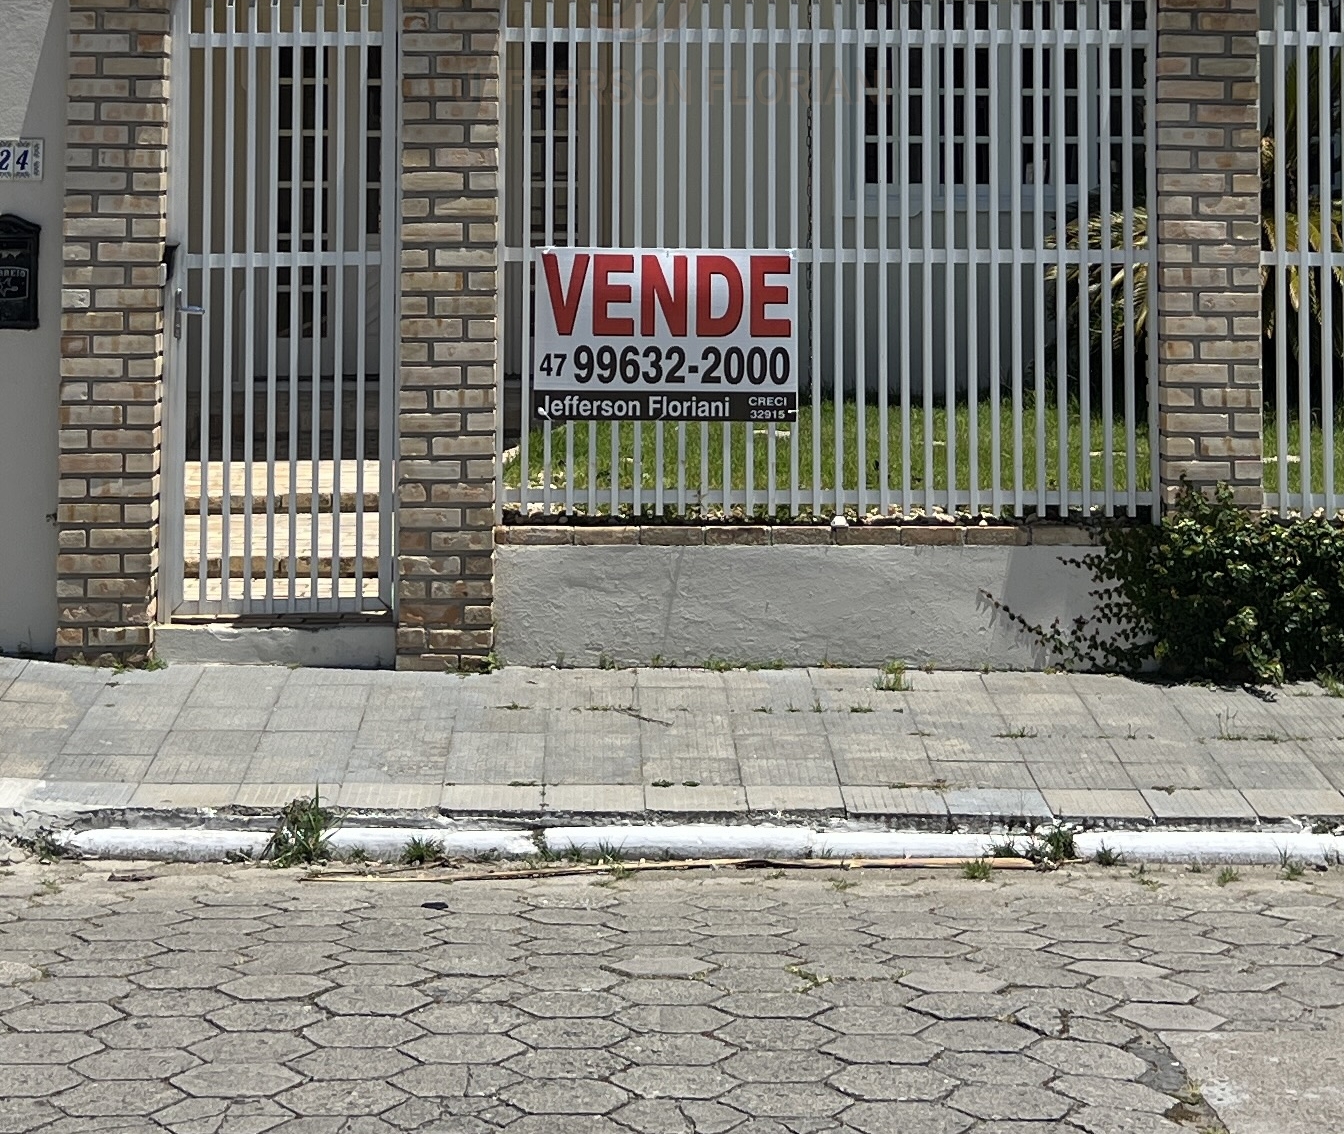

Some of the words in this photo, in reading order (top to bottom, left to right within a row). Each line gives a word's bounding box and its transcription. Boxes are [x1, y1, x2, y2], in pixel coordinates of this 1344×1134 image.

[542, 253, 792, 338] VENDE
[539, 353, 567, 377] 47
[573, 345, 790, 385] 99632-2000
[538, 395, 641, 416] Jefferson
[649, 396, 730, 417] Floriani
[748, 396, 787, 406] CRECI
[750, 409, 785, 419] 32915
